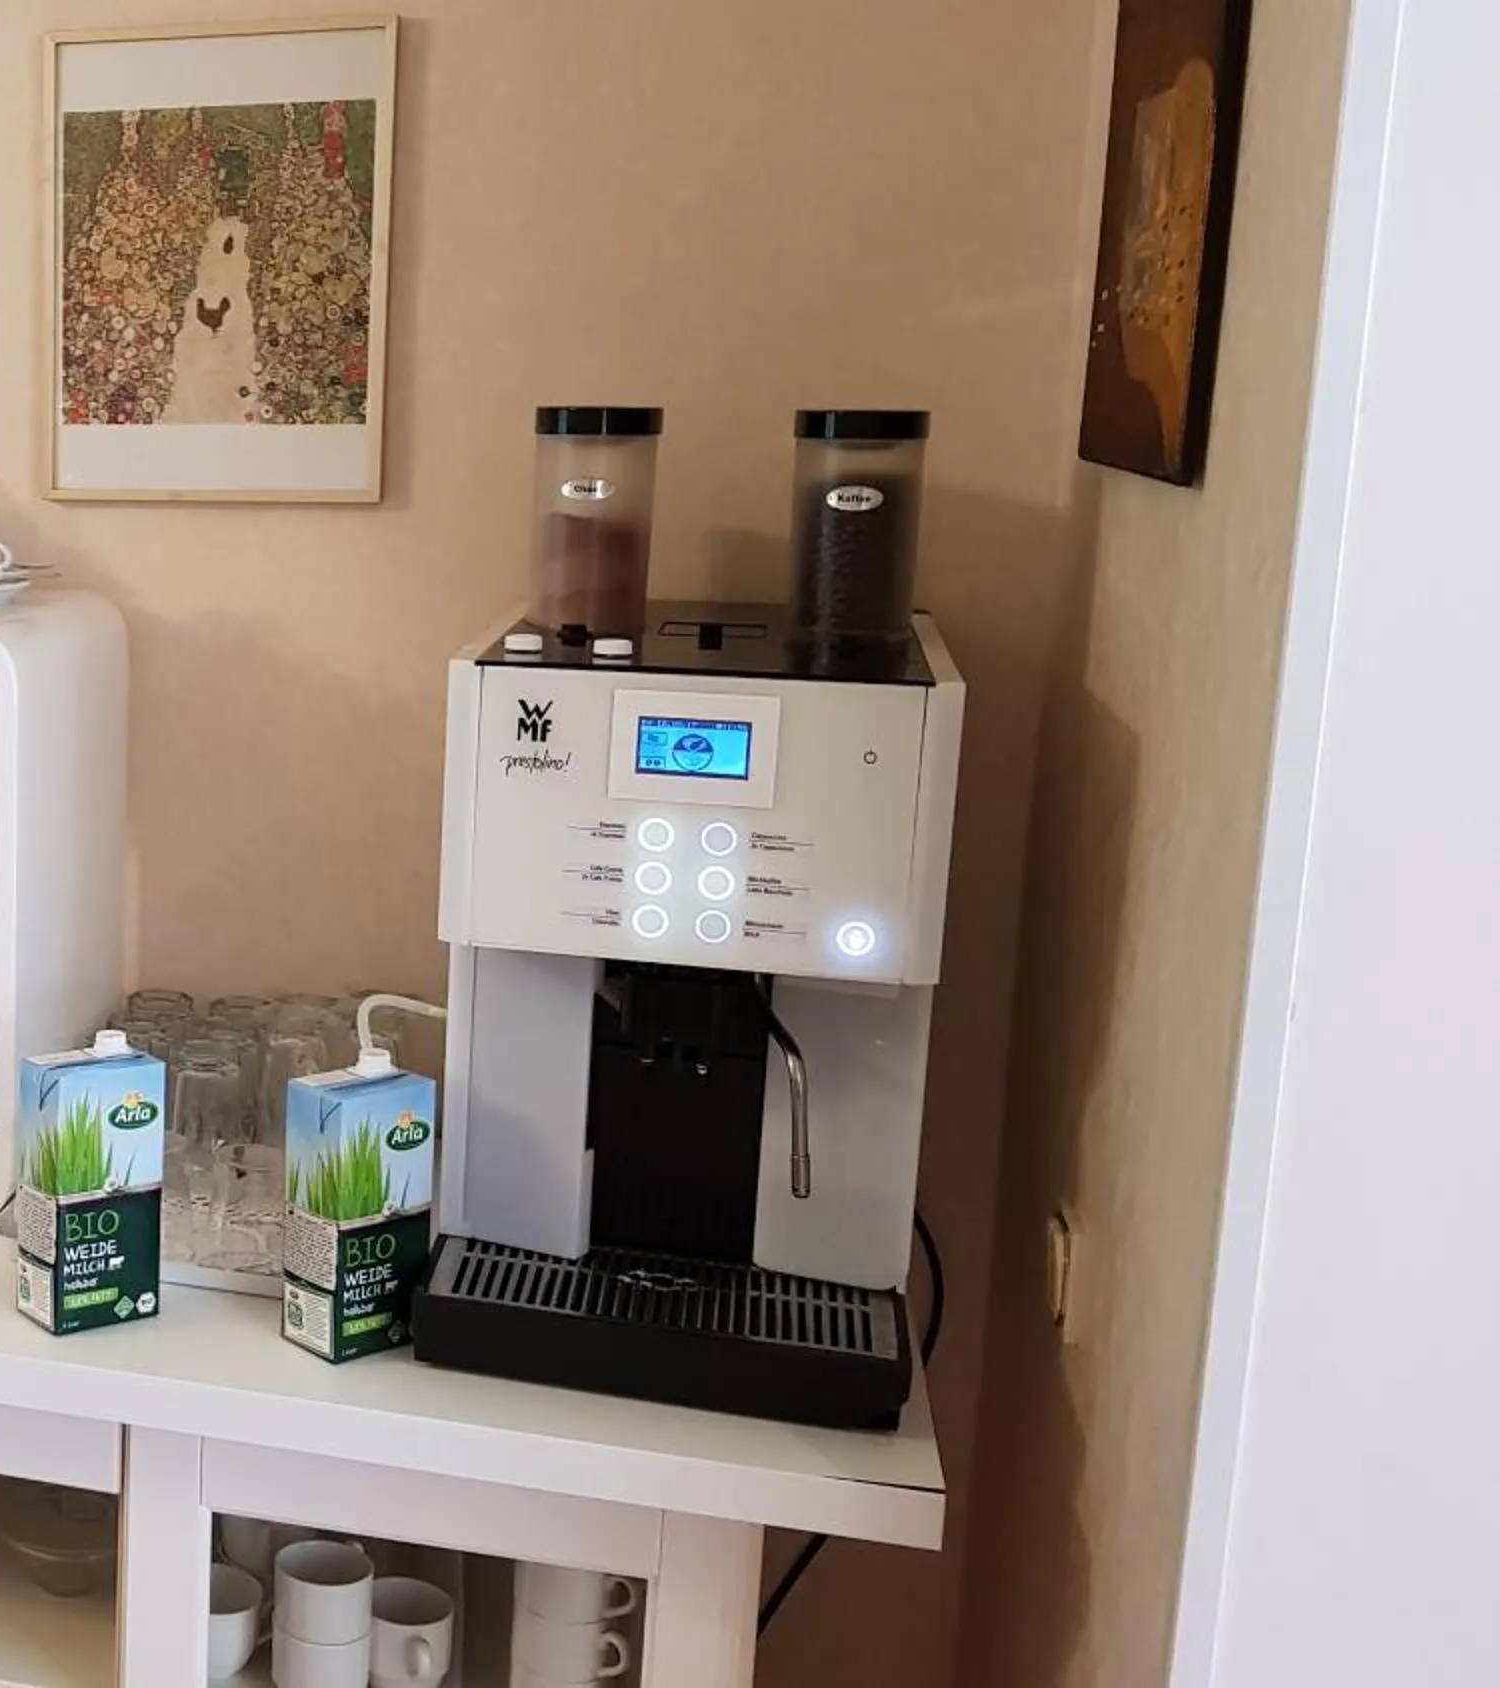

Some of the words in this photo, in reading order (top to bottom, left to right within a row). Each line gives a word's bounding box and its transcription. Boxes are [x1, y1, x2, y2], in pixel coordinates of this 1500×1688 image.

[114, 1105, 151, 1124] Arla
[390, 1125, 424, 1146] Arla
[64, 1208, 120, 1242] BIO
[63, 1239, 117, 1263] WEIDE
[345, 1233, 396, 1269] BIO
[63, 1258, 106, 1278] MILCH
[343, 1263, 394, 1287] WEIDE
[343, 1282, 383, 1304] MILCH
